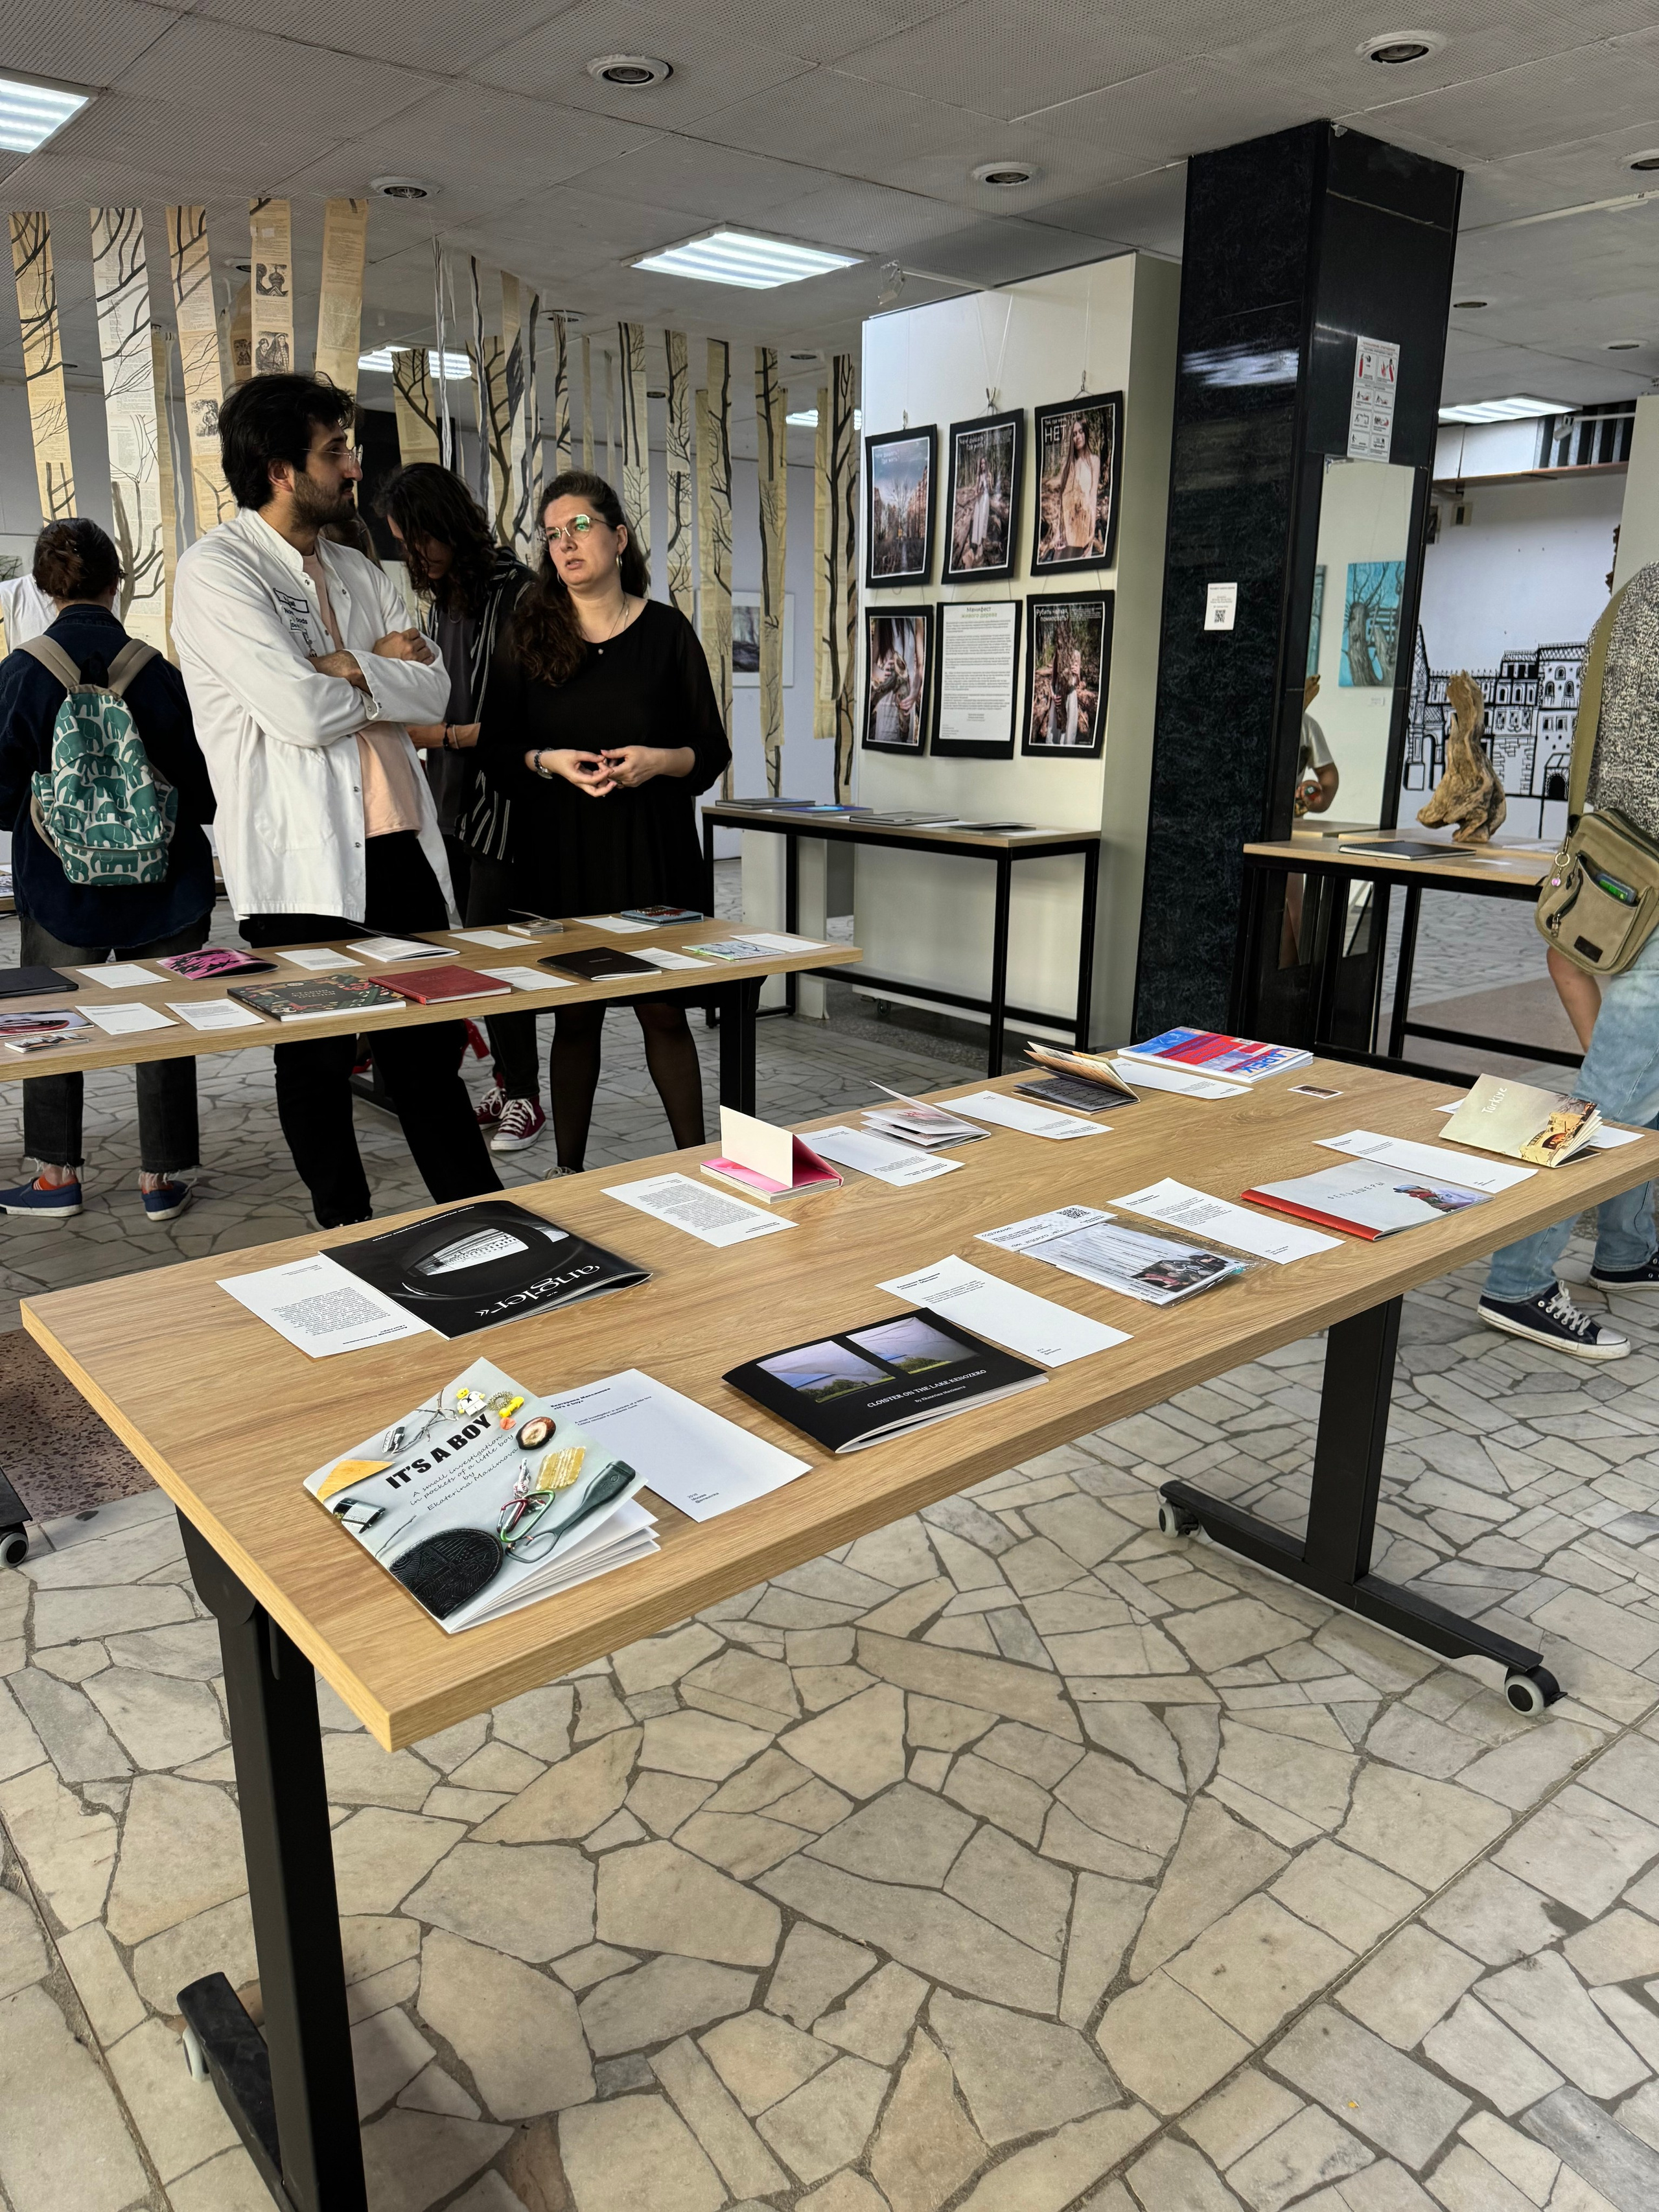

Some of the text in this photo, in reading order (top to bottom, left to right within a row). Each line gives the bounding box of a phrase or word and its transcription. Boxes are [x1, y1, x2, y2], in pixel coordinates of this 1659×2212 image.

[1045, 425, 1067, 443] НЕТ
[1327, 1182, 1386, 1200] ФЕЛЬДШЕРЫ
[867, 1393, 904, 1408] CLOISTER
[914, 1385, 931, 1393] THE
[929, 1380, 951, 1390] LAKE
[949, 1369, 986, 1384] KENOZERO
[922, 1391, 944, 1402] Ekaterina
[943, 1386, 966, 1395] Maximova
[385, 1413, 492, 1489] IT'S A BOY
[410, 1497, 423, 1506] in
[423, 1476, 456, 1499] pockets
[458, 1468, 467, 1478] of
[475, 1447, 498, 1465] little
[498, 1434, 514, 1447] boy
[422, 1474, 448, 1492] small
[448, 1434, 504, 1474] investigation
[427, 1447, 519, 1511] Ekaterina Maximova
[463, 1471, 476, 1481] by
